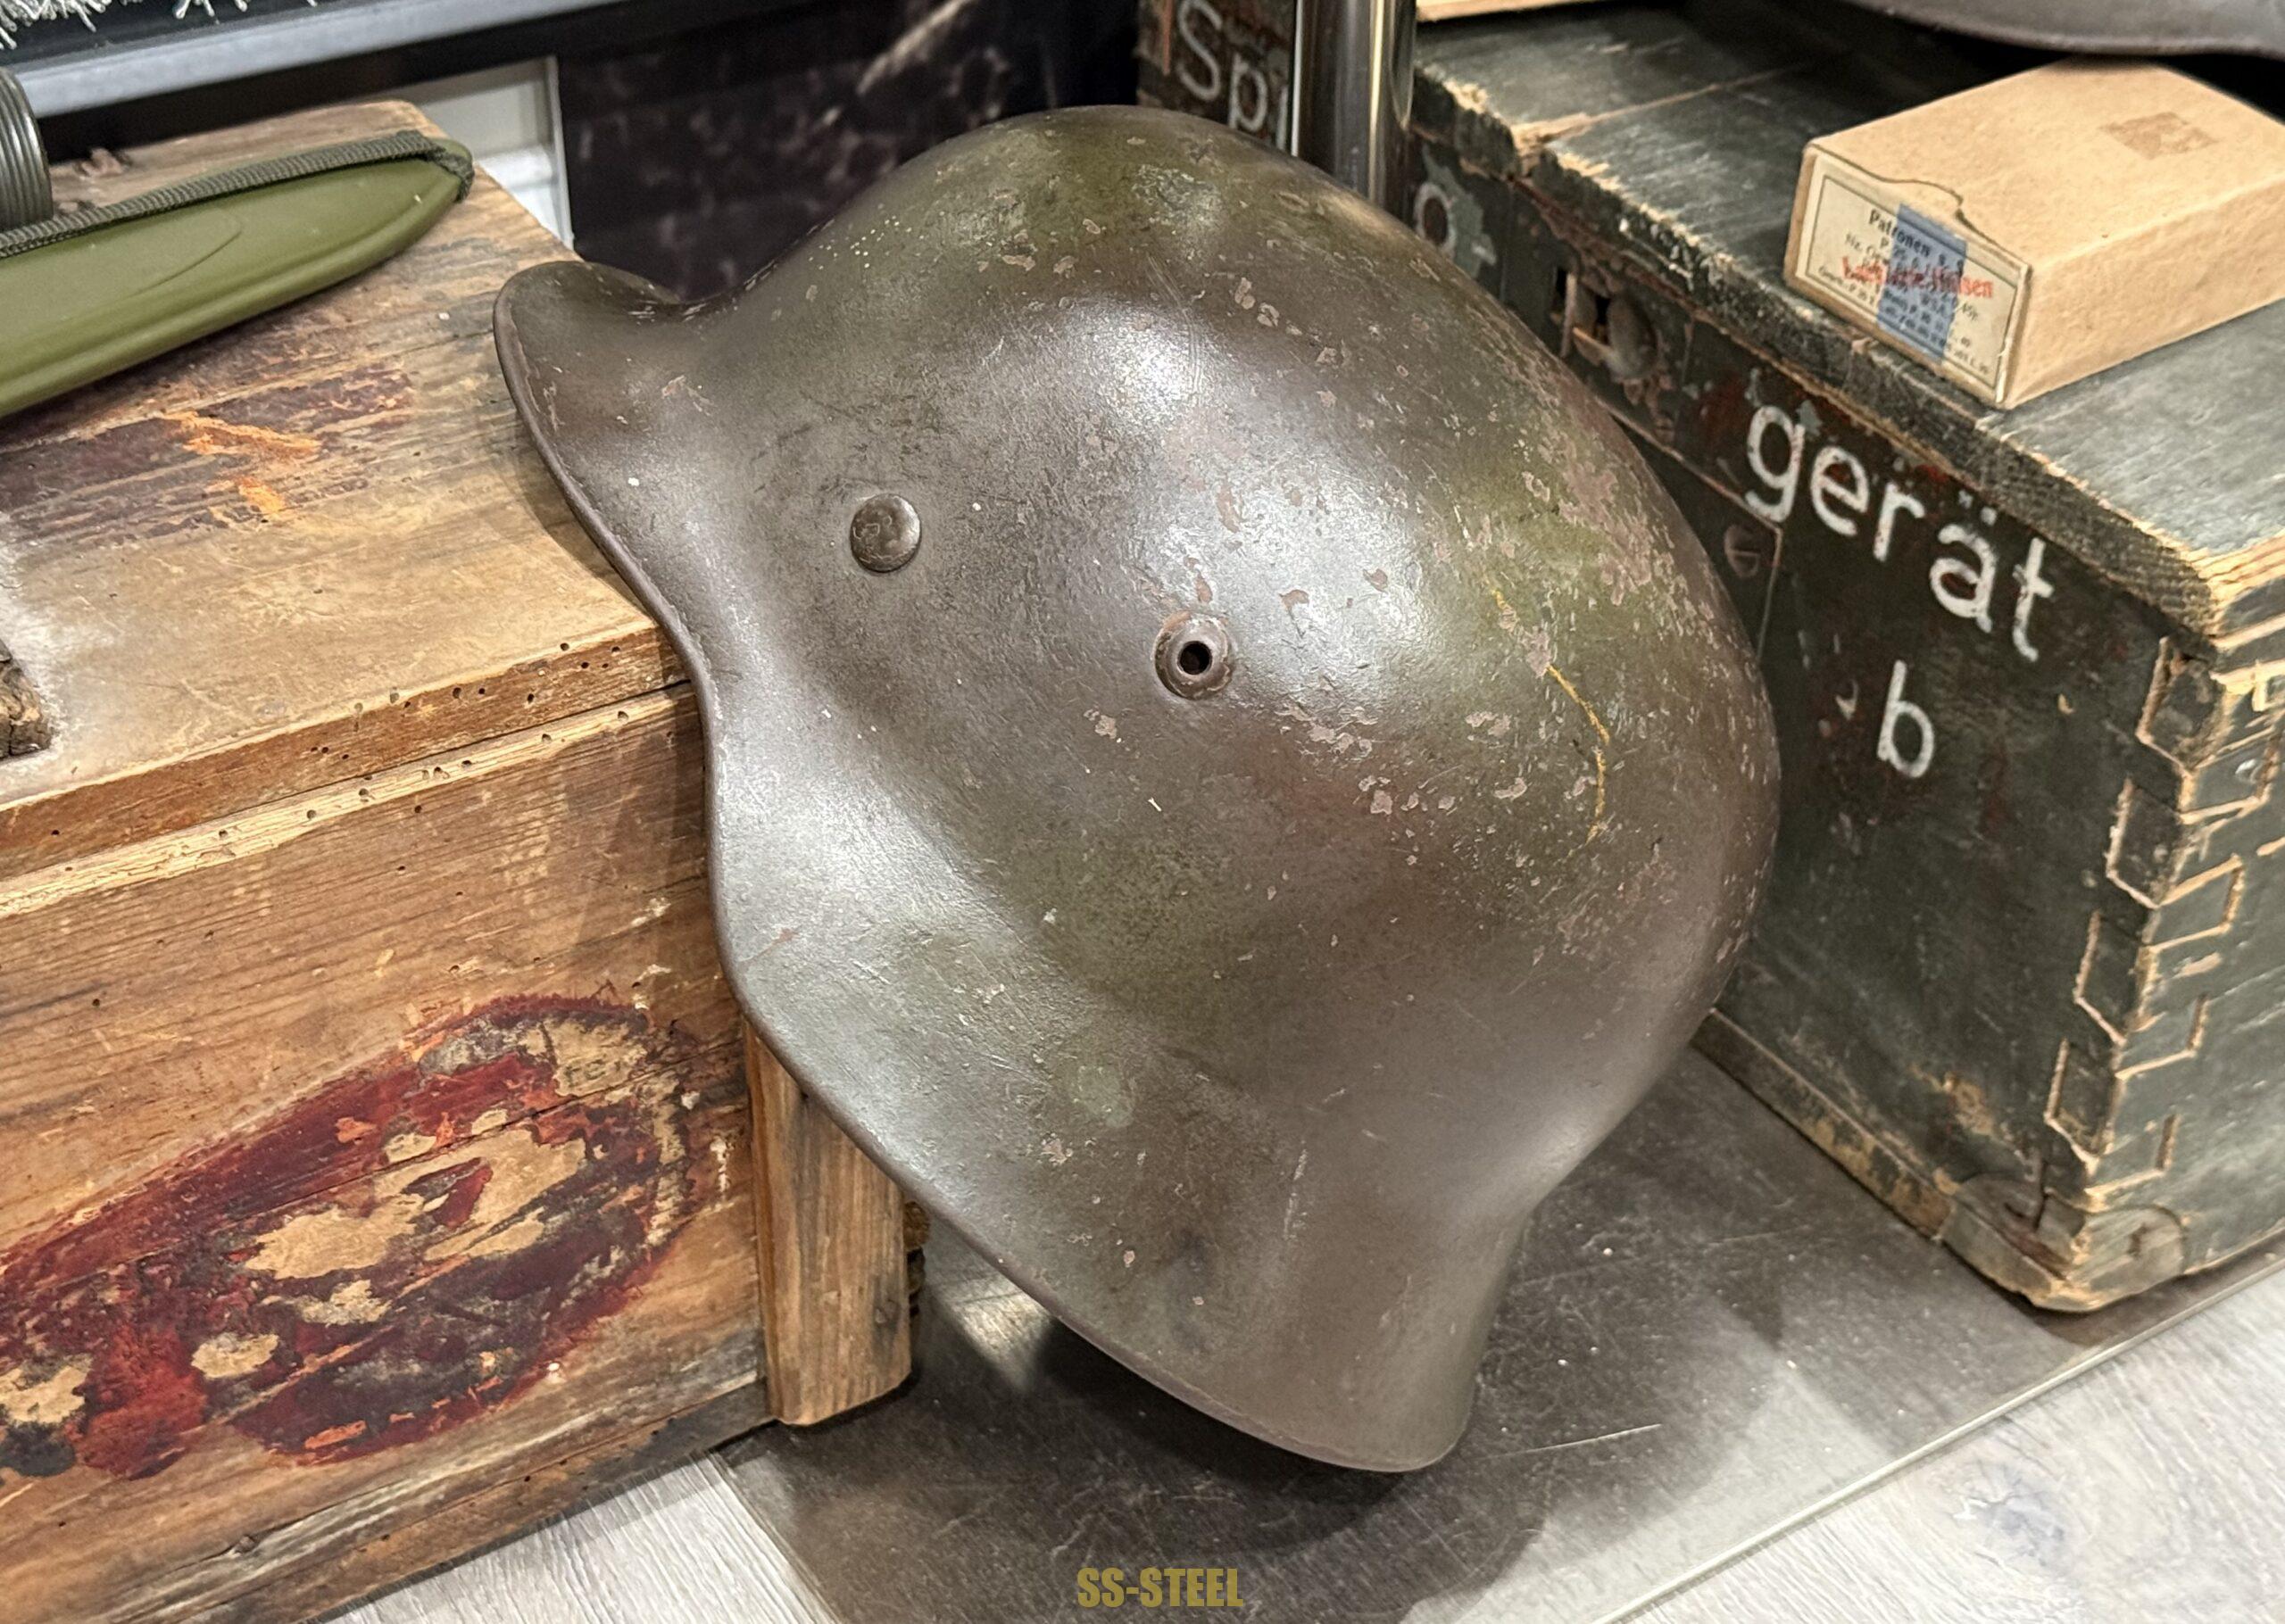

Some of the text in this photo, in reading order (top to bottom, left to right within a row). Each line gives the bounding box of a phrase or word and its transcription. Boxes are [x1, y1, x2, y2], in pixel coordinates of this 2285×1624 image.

[1868, 208, 1932, 258] Patronen
[1745, 405, 2054, 662] gerät
[1877, 659, 1935, 779] b
